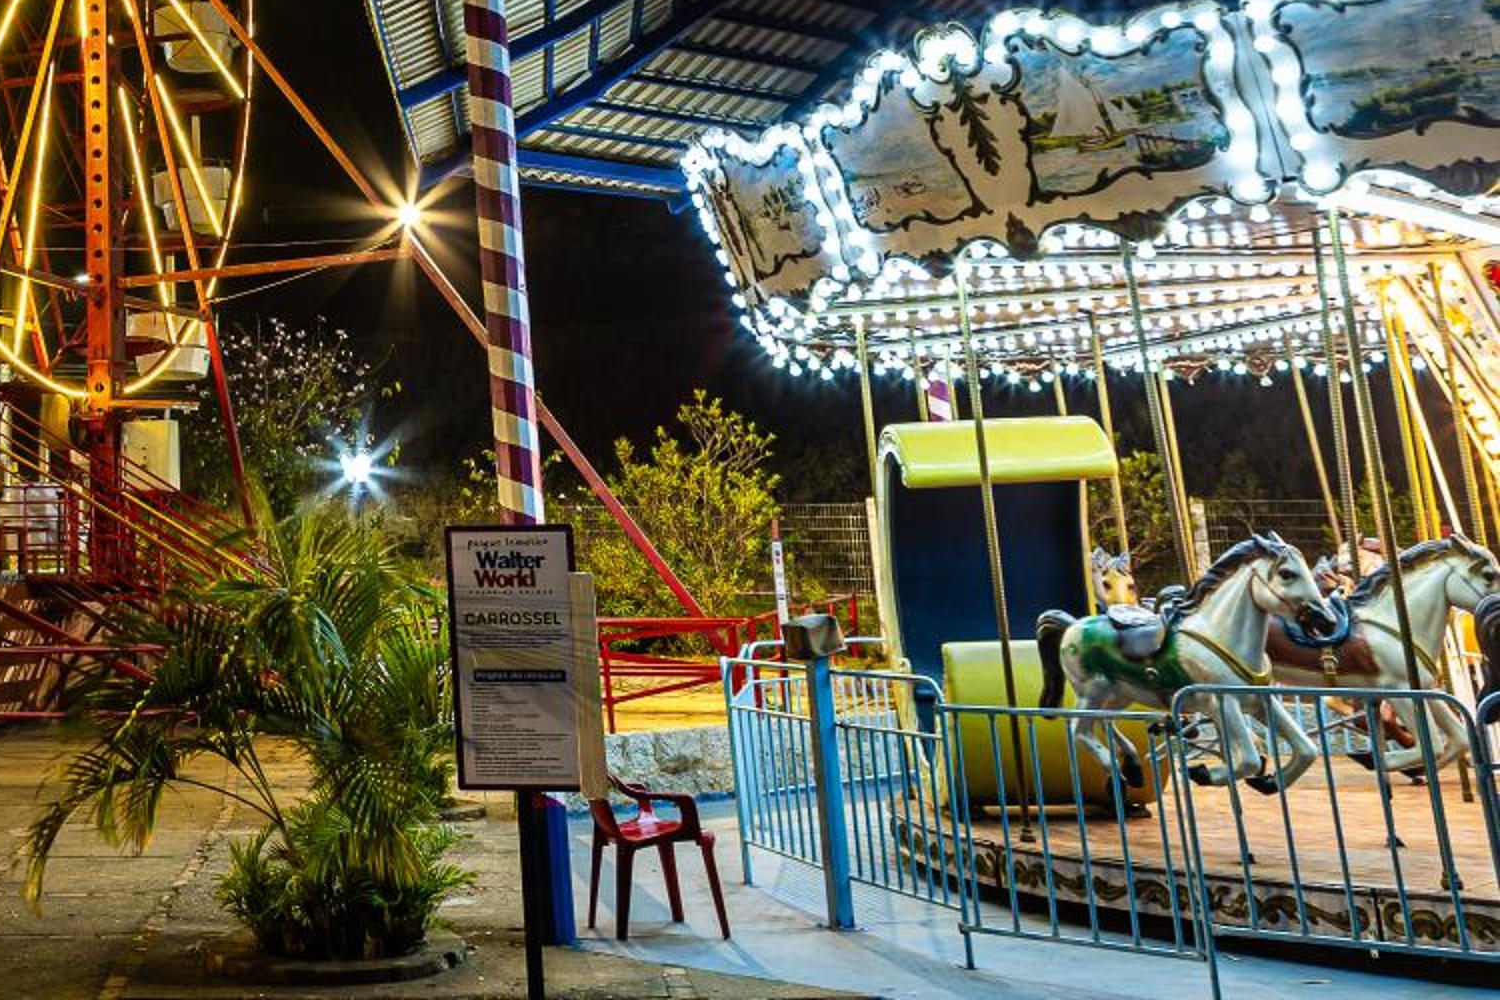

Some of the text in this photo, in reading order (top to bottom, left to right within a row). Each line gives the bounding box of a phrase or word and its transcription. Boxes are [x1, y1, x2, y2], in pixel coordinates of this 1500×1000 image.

[475, 550, 545, 569] Walter
[473, 568, 537, 588] World
[464, 611, 561, 626] CARROSSEL
